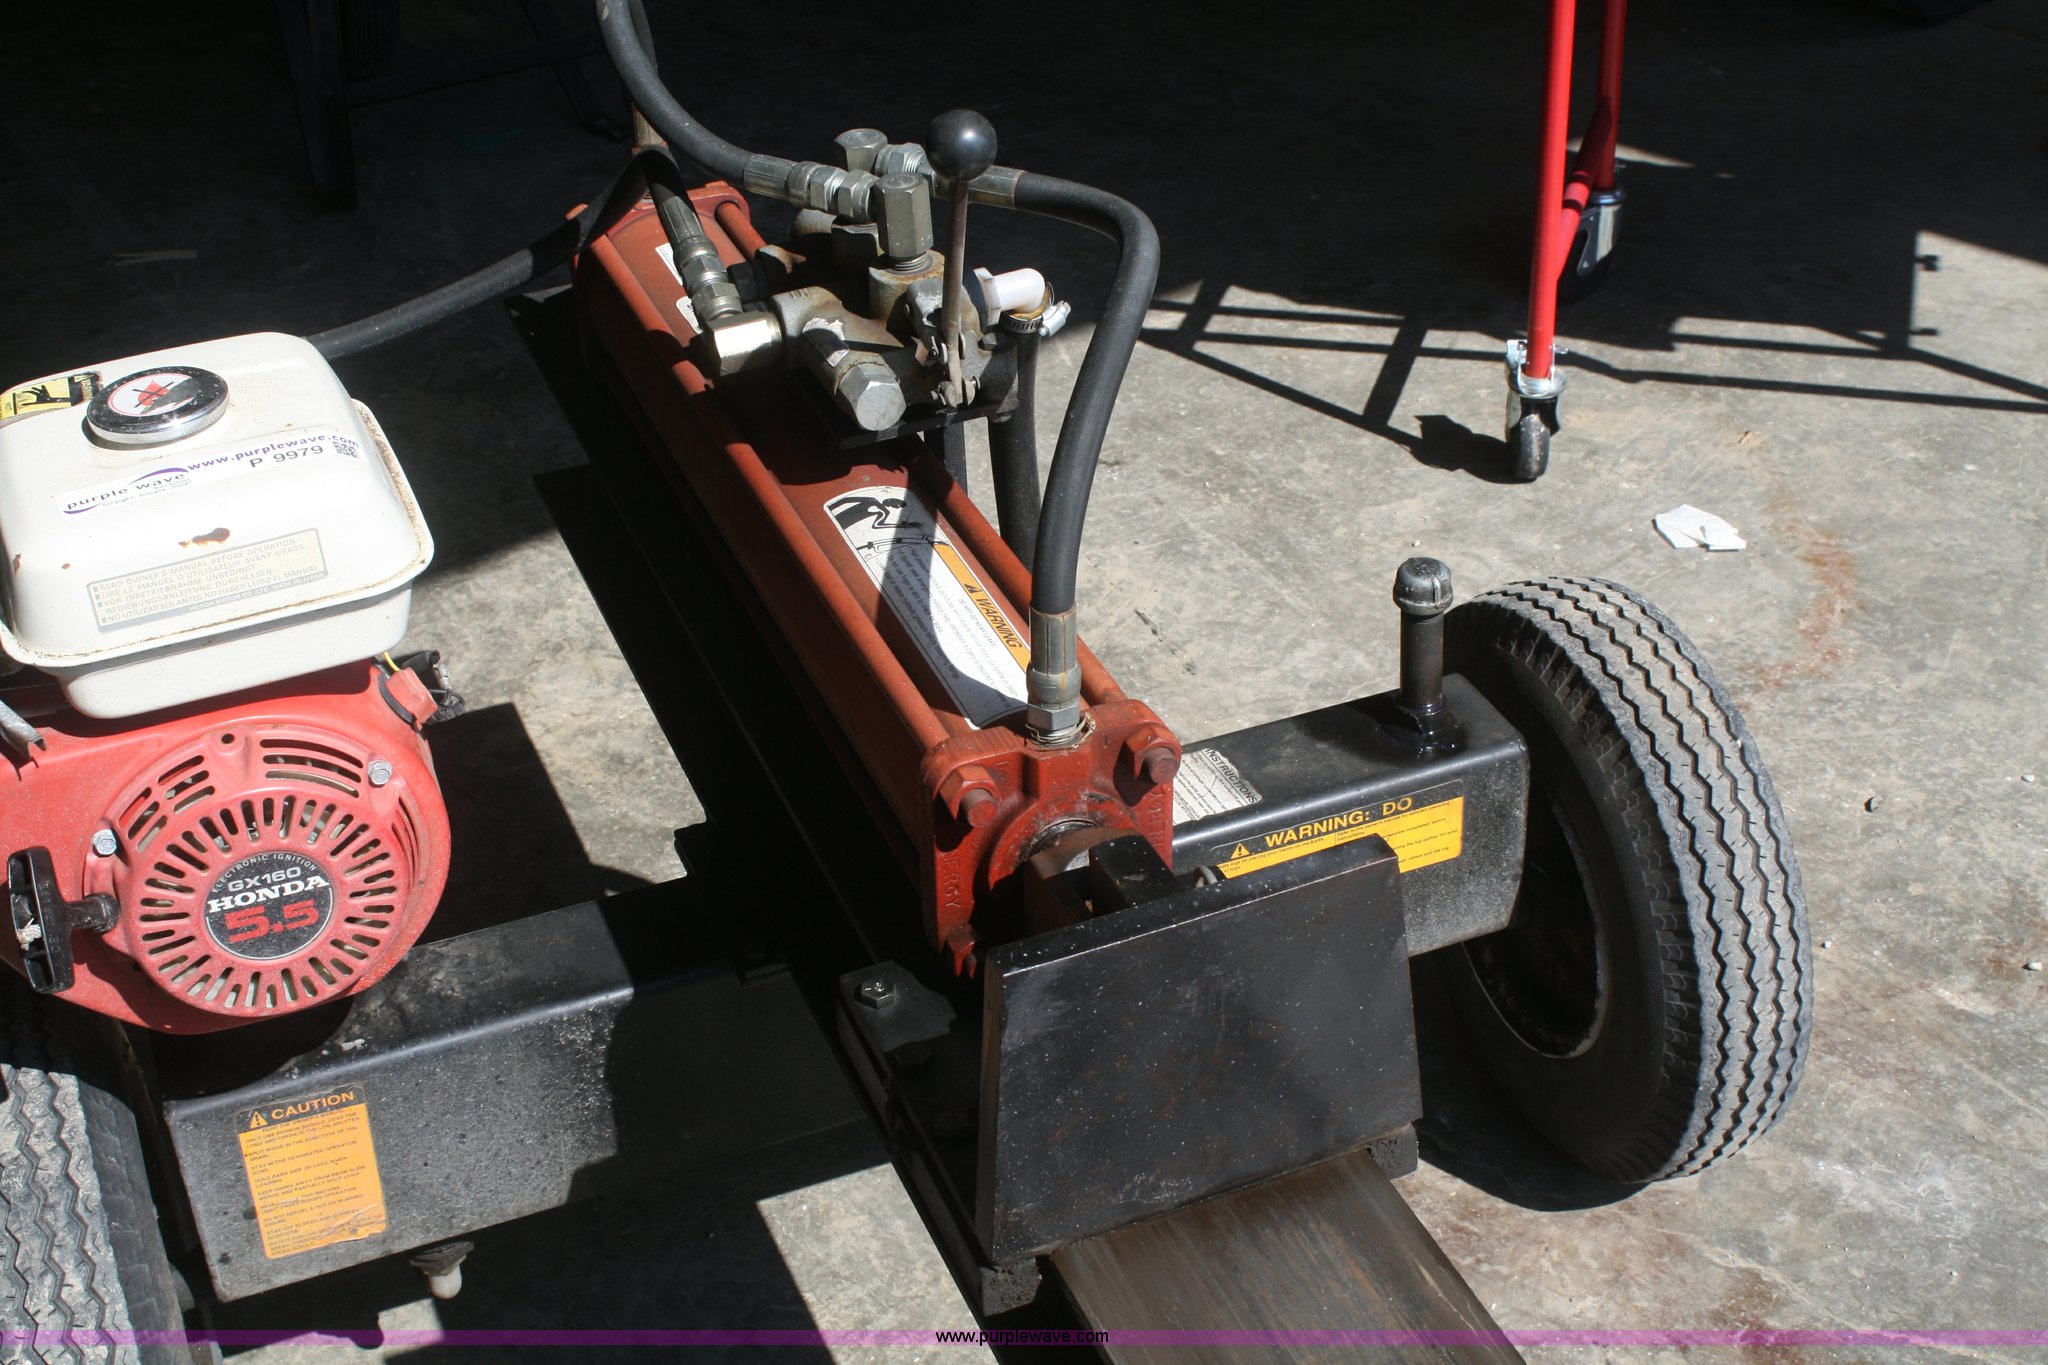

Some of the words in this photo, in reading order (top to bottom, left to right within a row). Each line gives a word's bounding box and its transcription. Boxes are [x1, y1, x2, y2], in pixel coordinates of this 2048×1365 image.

[187, 433, 360, 471] www.purplewave.com
[249, 457, 264, 468] P
[273, 445, 324, 463] 9979
[67, 488, 128, 510] purple
[136, 473, 185, 490] wave
[169, 559, 208, 574] MANUAL
[209, 551, 243, 564] BEFORE
[246, 538, 295, 555] OPERATION
[974, 596, 1023, 649] WARNING
[1204, 748, 1259, 804] INSTRUCTIONS
[1264, 809, 1371, 848] WARNING:
[1382, 796, 1413, 816] DO
[212, 854, 269, 893] ELECTRONIC
[273, 853, 317, 871] IGNITION
[228, 866, 301, 892] GX160
[207, 875, 330, 913] HONDA
[225, 899, 319, 943] 5.5
[271, 1090, 355, 1120] CAUTION
